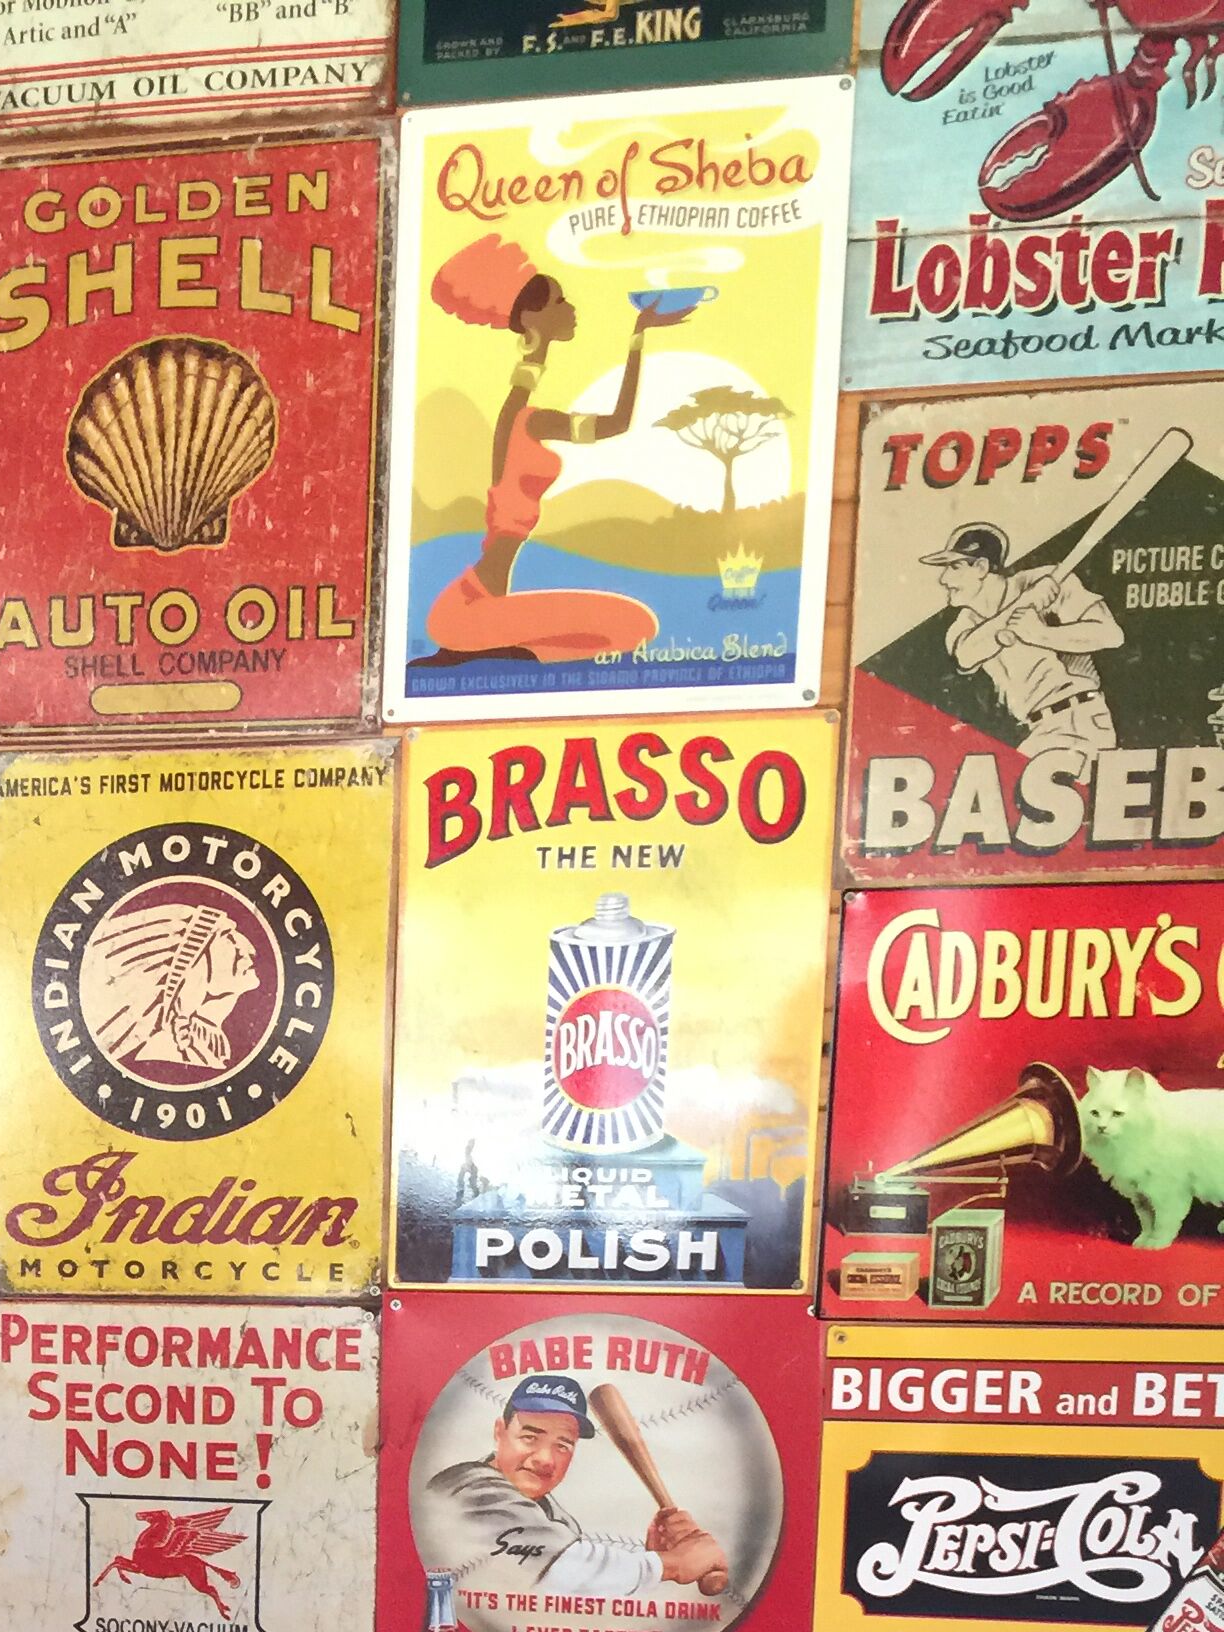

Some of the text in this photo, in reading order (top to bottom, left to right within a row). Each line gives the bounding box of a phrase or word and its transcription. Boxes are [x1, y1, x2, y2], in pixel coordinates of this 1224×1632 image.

[275, 0, 317, 19] and
[634, 7, 702, 45] KING
[3, 16, 101, 46] Artic and
[133, 74, 188, 98] OIL
[204, 61, 371, 92] COMPANY
[983, 50, 1056, 84] Lobster
[958, 76, 1035, 106] is Good
[23, 170, 329, 234] GOLDEN
[436, 132, 814, 236] Queen of Sheba
[569, 199, 803, 236] PURE ETHIOPIAN COFFEE
[869, 212, 1182, 324] Lobster
[922, 325, 1100, 361] Seafood
[882, 420, 1115, 491] TOPPS
[1111, 545, 1204, 575] PICTURE
[1126, 581, 1211, 609] BUBBLE
[225, 583, 357, 645] OIL
[64, 647, 288, 680] SHELL COMPANY
[631, 636, 718, 665] Arabica
[722, 632, 788, 663] Blend
[99, 772, 151, 796] FIRST
[160, 768, 286, 794] MOTORCYCLE
[293, 765, 388, 788] COMPANY
[423, 731, 807, 869] BRASSO
[536, 843, 686, 871] THE NEW
[43, 834, 324, 1076] INDIAN MOTORCYCLE
[866, 908, 1203, 1046] CADBURY'S
[559, 1009, 657, 1080] BRASSO
[130, 1096, 233, 1129] 1901
[4, 1150, 360, 1248] Indian
[474, 1228, 720, 1273] POLISH
[19, 1257, 345, 1283] MOTORCYCLE
[1017, 1282, 1038, 1304] A
[1049, 1282, 1162, 1306] RECORD
[0, 1313, 362, 1372] PERFORMANCE
[488, 1335, 711, 1387] BABE RUTH
[27, 1370, 324, 1428] SECOND TO
[830, 1367, 1043, 1415] BIGGER
[1055, 1386, 1119, 1417] and
[489, 1526, 545, 1566] Says
[506, 1592, 722, 1623] THE FINEST COLA DRINK
